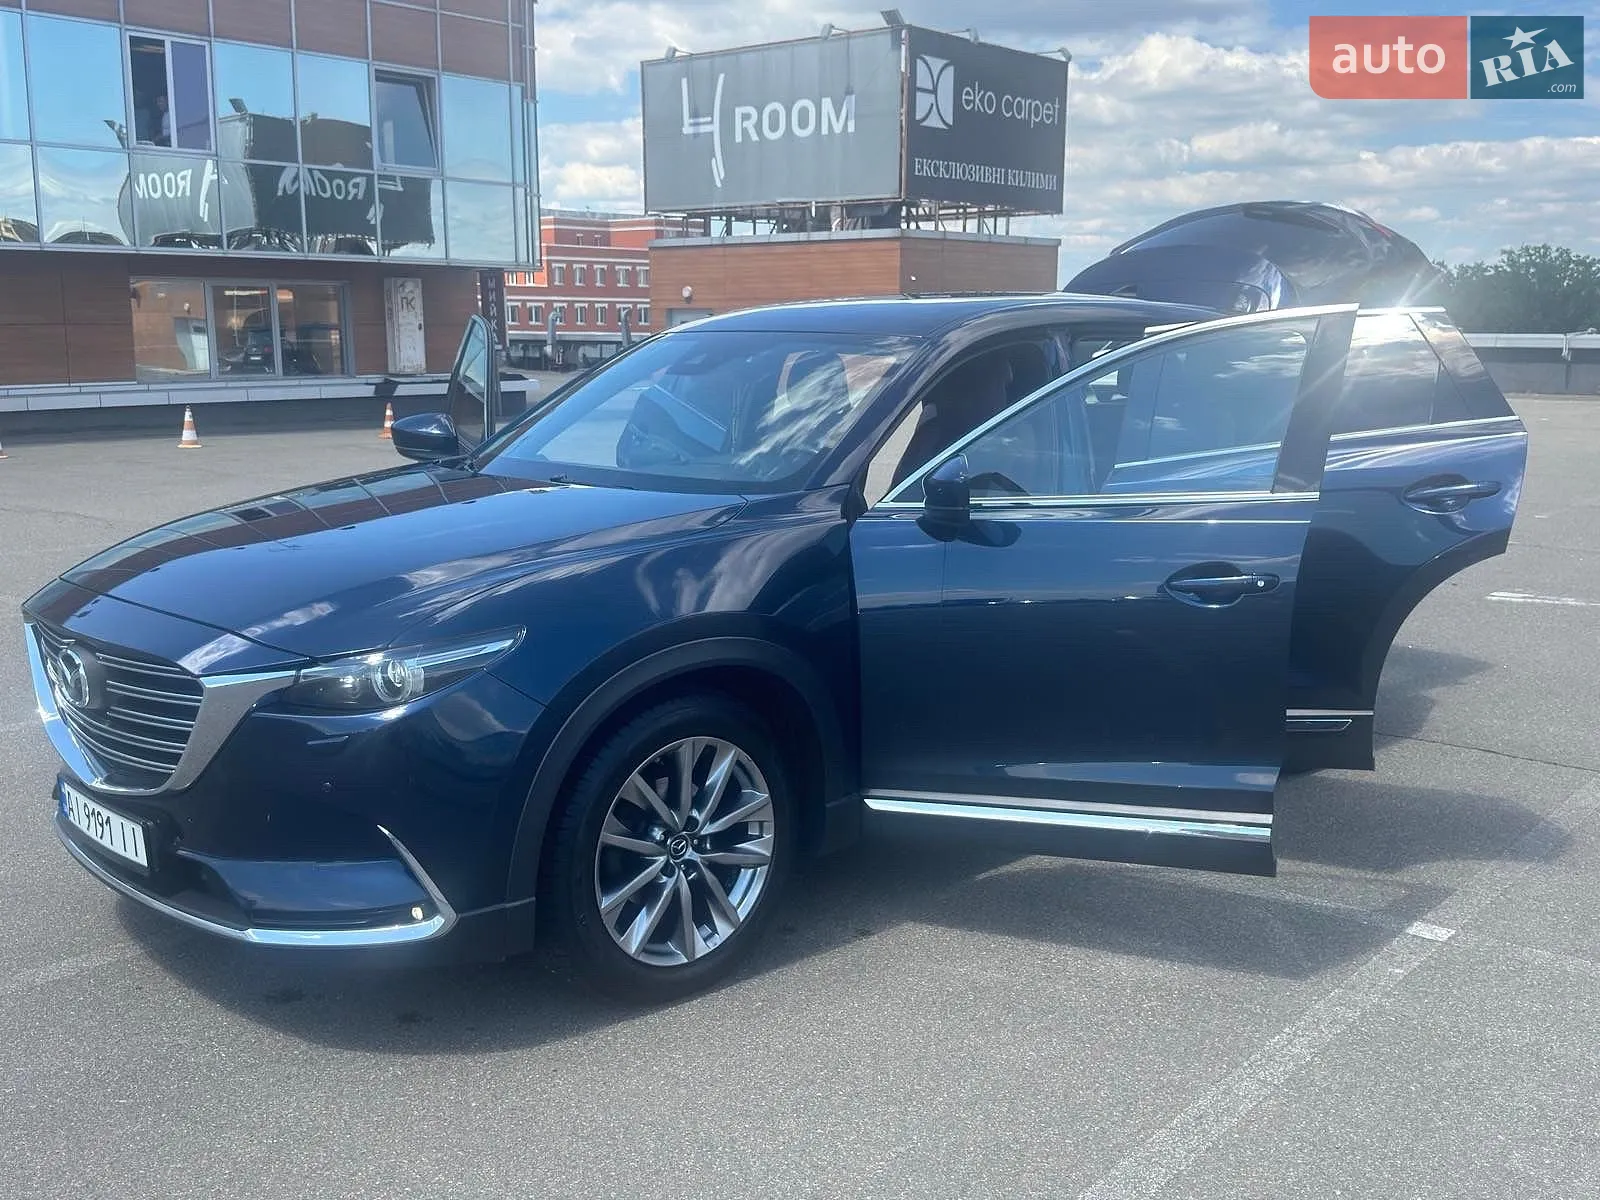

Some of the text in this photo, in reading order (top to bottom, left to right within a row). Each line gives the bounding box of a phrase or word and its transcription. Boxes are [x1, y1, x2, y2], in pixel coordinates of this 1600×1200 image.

[734, 94, 856, 144] ROOM
[961, 81, 1061, 129] eko carpet
[914, 158, 1058, 191] ЕКСКЛЮЗИВНІ КИЛИМИ
[83, 801, 114, 848] 9191
